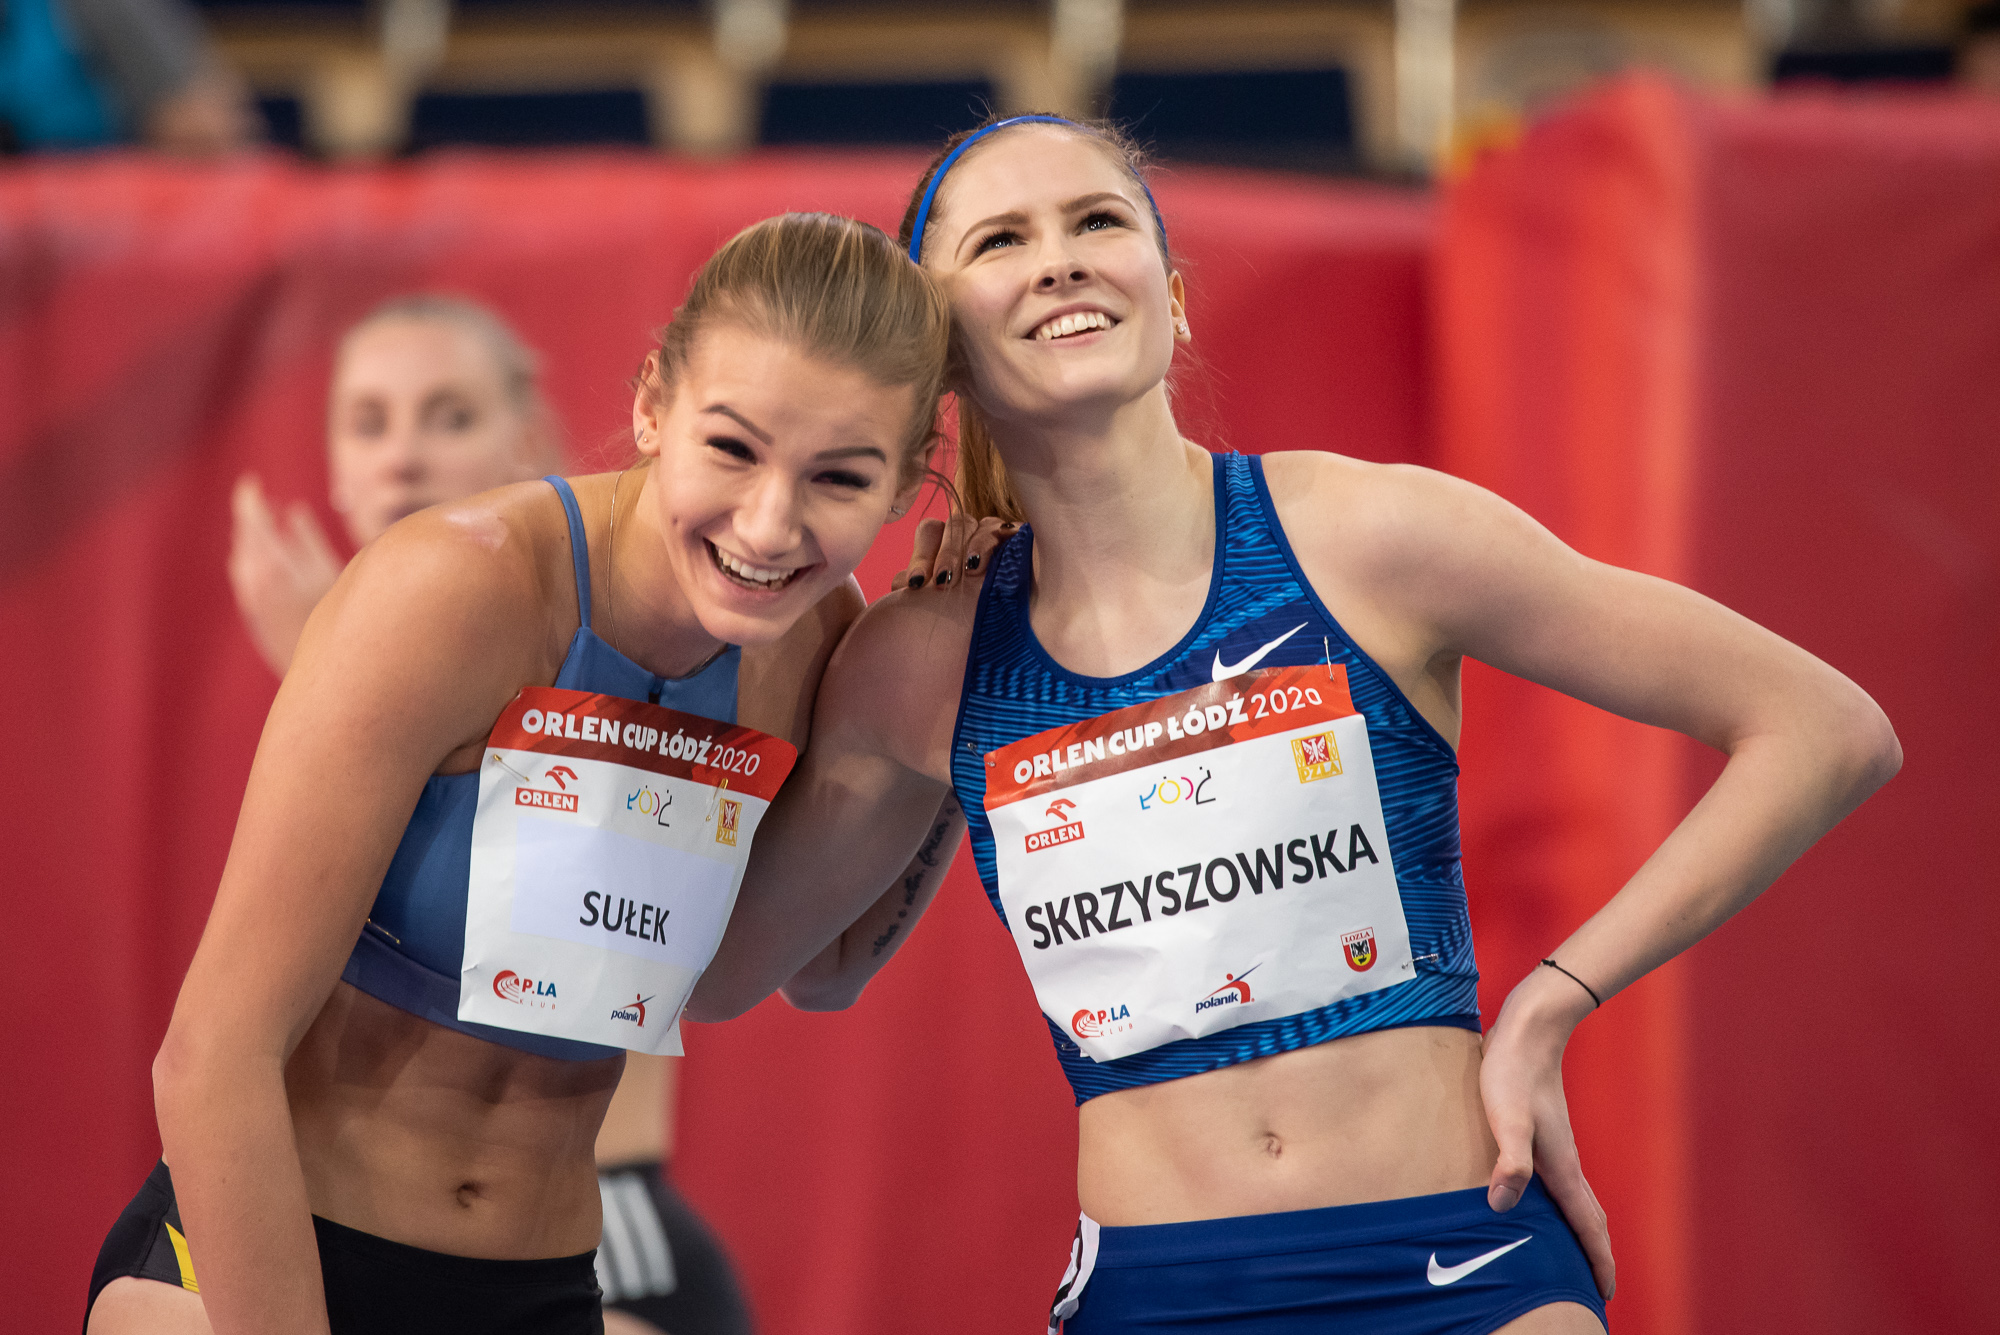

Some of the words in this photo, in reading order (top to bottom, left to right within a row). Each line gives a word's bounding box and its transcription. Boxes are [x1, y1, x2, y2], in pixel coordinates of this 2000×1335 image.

[521, 708, 621, 745] ORLEN
[622, 723, 658, 752] CUP
[658, 728, 712, 765] ŁÓDŹ
[710, 744, 761, 776] 2020
[1014, 736, 1105, 784] ORLEN
[1108, 721, 1163, 756] CUP
[1167, 692, 1249, 741] ŁÓDŹ
[1250, 686, 1323, 720] 2020
[1300, 764, 1340, 780] PZLA
[518, 789, 575, 811] ORLEN
[1027, 823, 1081, 850] ORLEN
[1025, 823, 1379, 950] SKRZYSZOWSKA
[579, 891, 670, 945] SUŁEK
